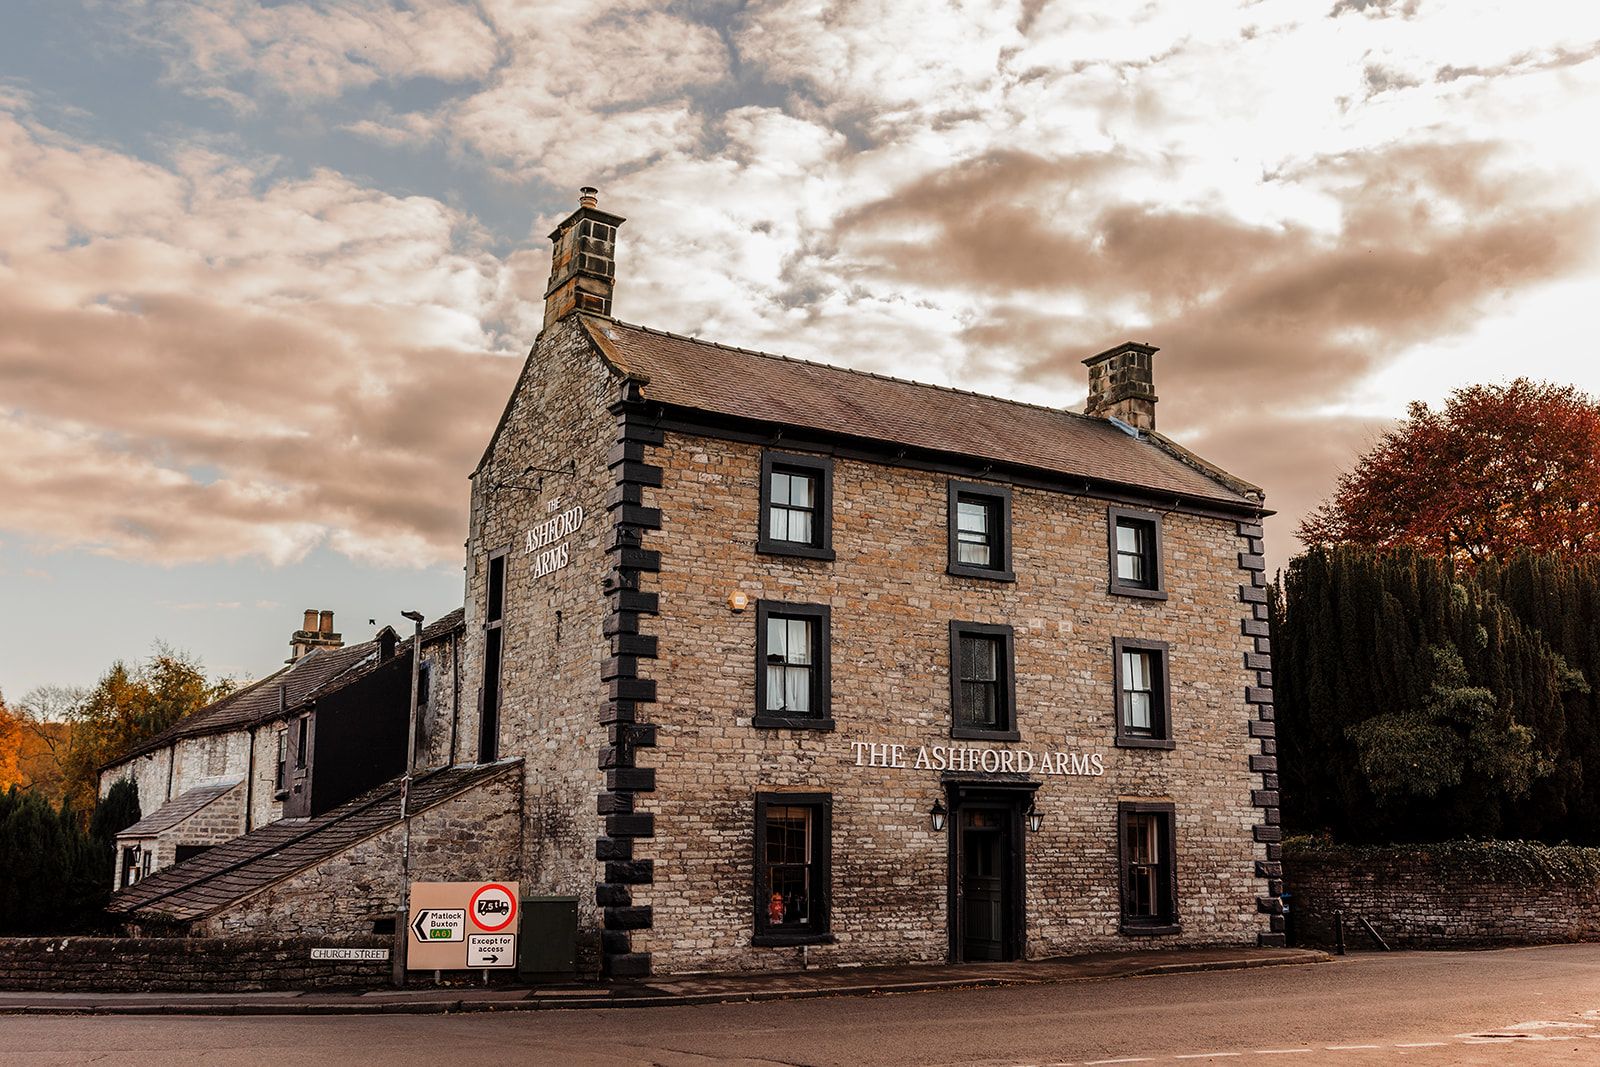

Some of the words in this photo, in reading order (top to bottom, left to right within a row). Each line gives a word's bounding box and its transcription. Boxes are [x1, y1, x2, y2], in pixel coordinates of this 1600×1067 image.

[547, 496, 561, 513] THE
[524, 505, 583, 554] ASHFORD
[533, 542, 570, 579] ARMS
[850, 741, 906, 768] THE
[914, 746, 1034, 773] ASHFORD
[1039, 751, 1105, 776] ARMS
[430, 912, 462, 920] Matlock
[430, 920, 458, 928] Buxton
[471, 938, 498, 946] Except
[500, 937, 511, 945] for
[312, 949, 351, 959] CHURCH
[354, 949, 387, 959] STREET
